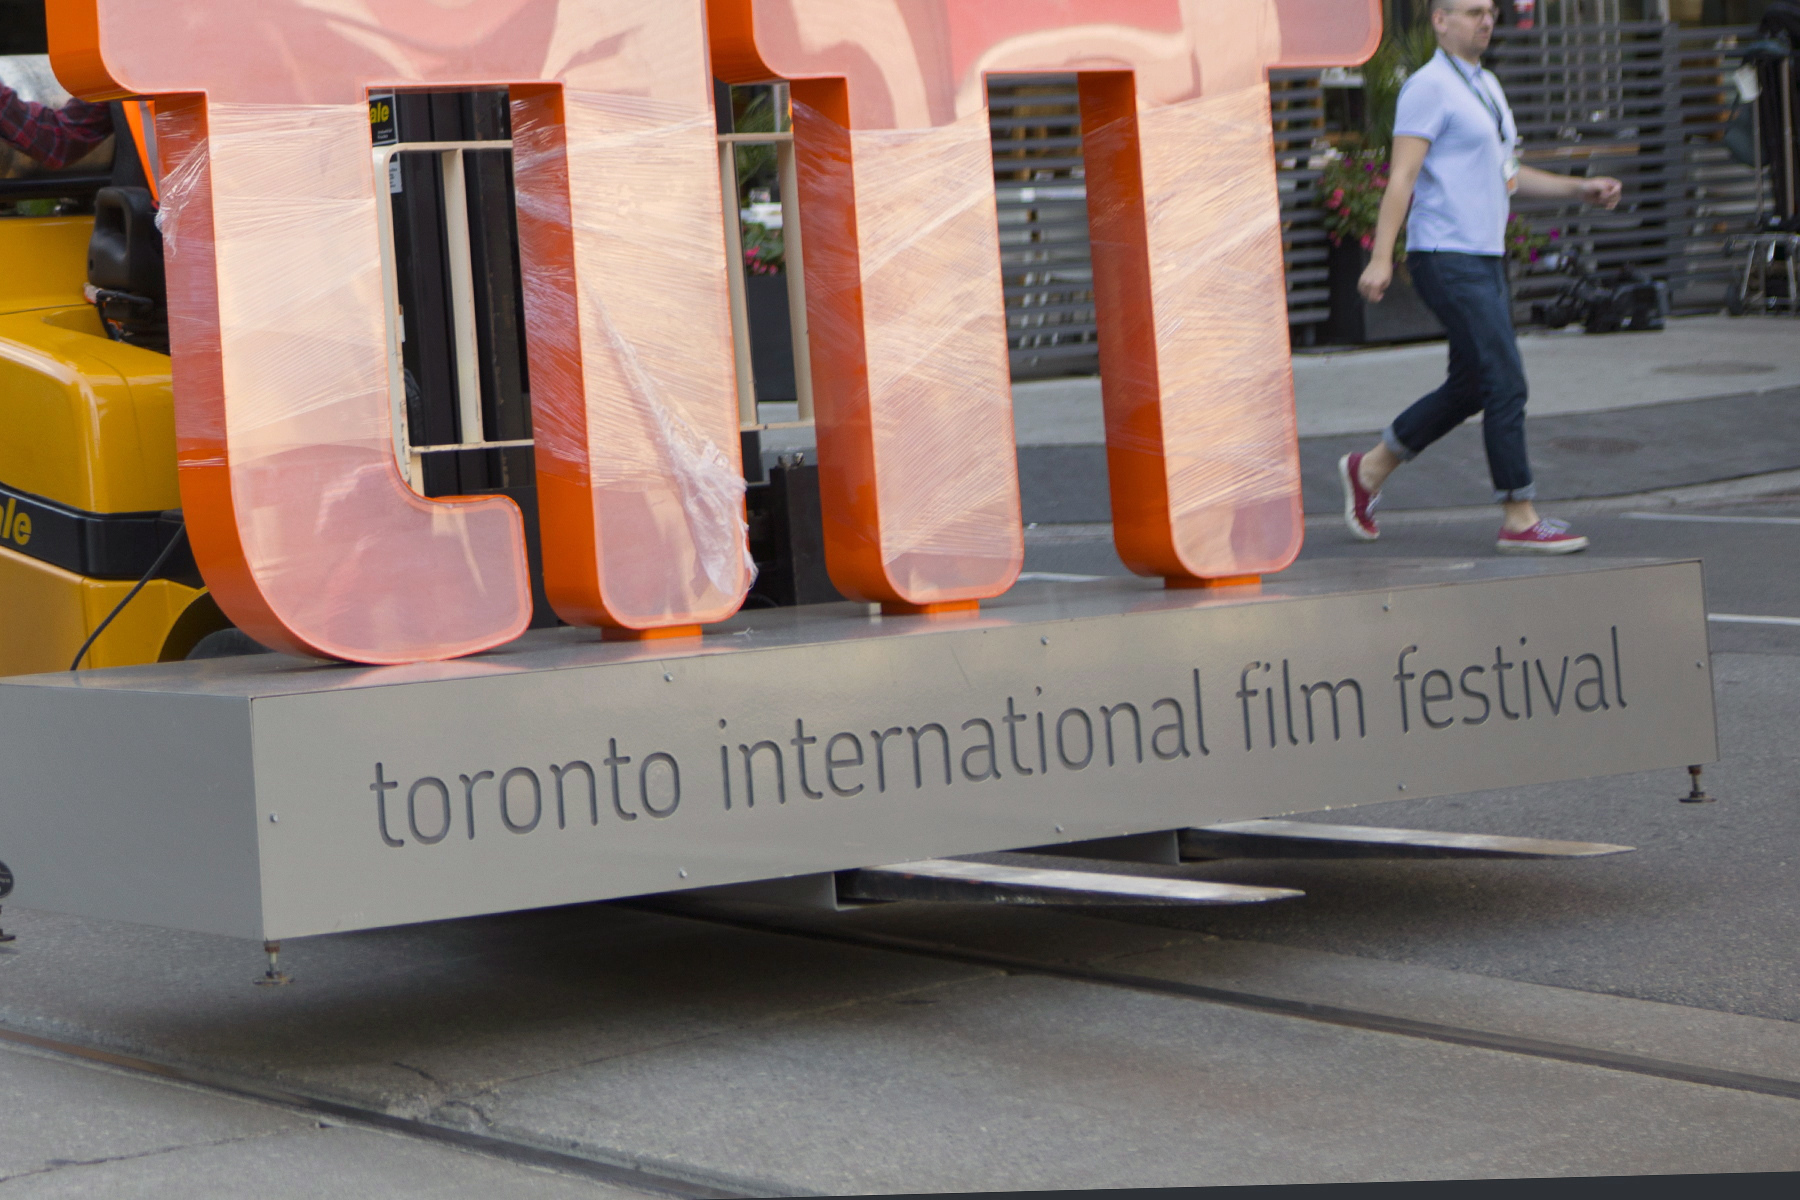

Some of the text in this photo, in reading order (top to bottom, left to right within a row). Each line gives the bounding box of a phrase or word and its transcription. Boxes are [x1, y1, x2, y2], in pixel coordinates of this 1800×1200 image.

[368, 102, 390, 125] ale
[368, 624, 1629, 849] toronto international film festival
